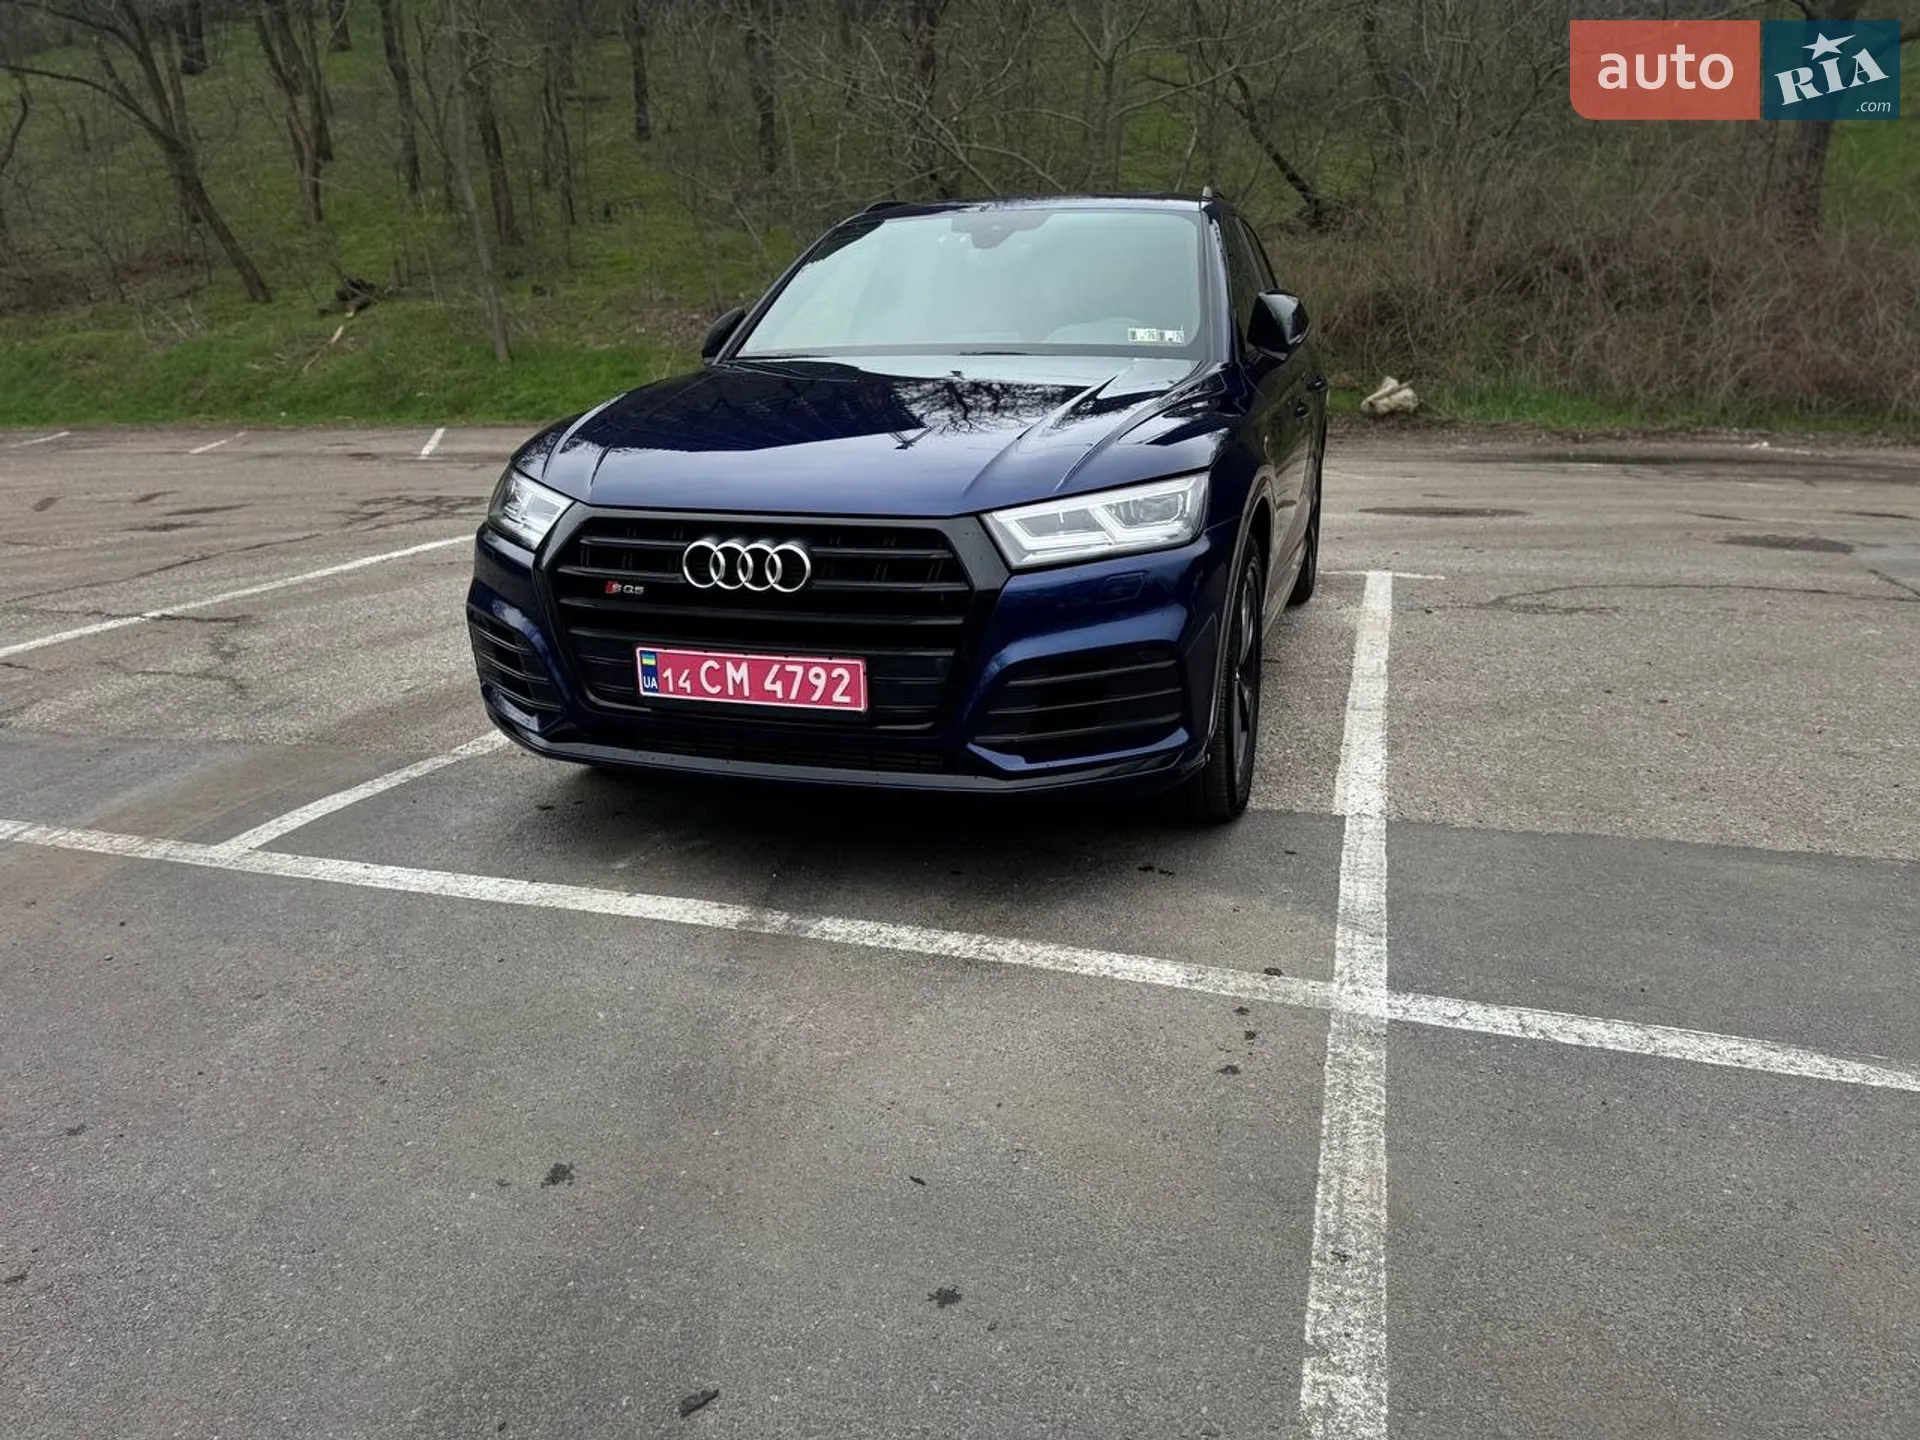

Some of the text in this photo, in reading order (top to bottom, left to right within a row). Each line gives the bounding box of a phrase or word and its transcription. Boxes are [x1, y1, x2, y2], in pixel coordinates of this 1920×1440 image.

[643, 675, 658, 689] UA
[662, 660, 851, 703] 14 CM 4792
